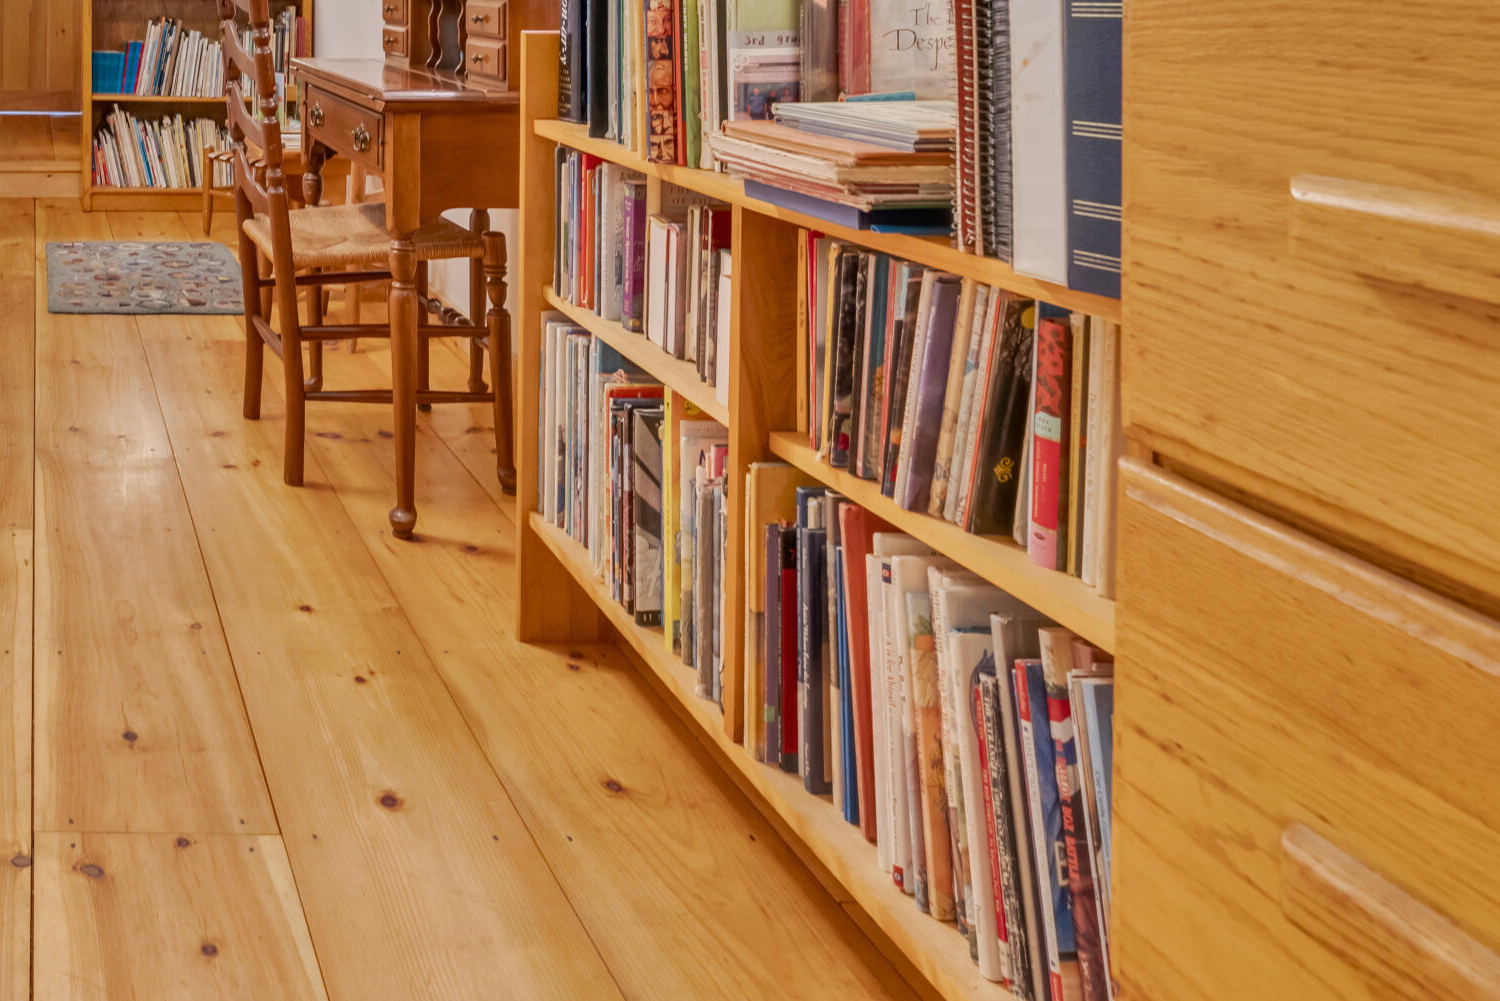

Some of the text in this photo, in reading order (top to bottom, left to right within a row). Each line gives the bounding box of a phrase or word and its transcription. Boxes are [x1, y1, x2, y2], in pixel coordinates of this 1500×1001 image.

[909, 0, 941, 26] The
[743, 35, 765, 47] 3rd
[985, 720, 998, 778] STRANGER
[1056, 756, 1071, 803] BALLOT
[1062, 805, 1074, 832] BOX
[1065, 835, 1080, 882] BATTLE
